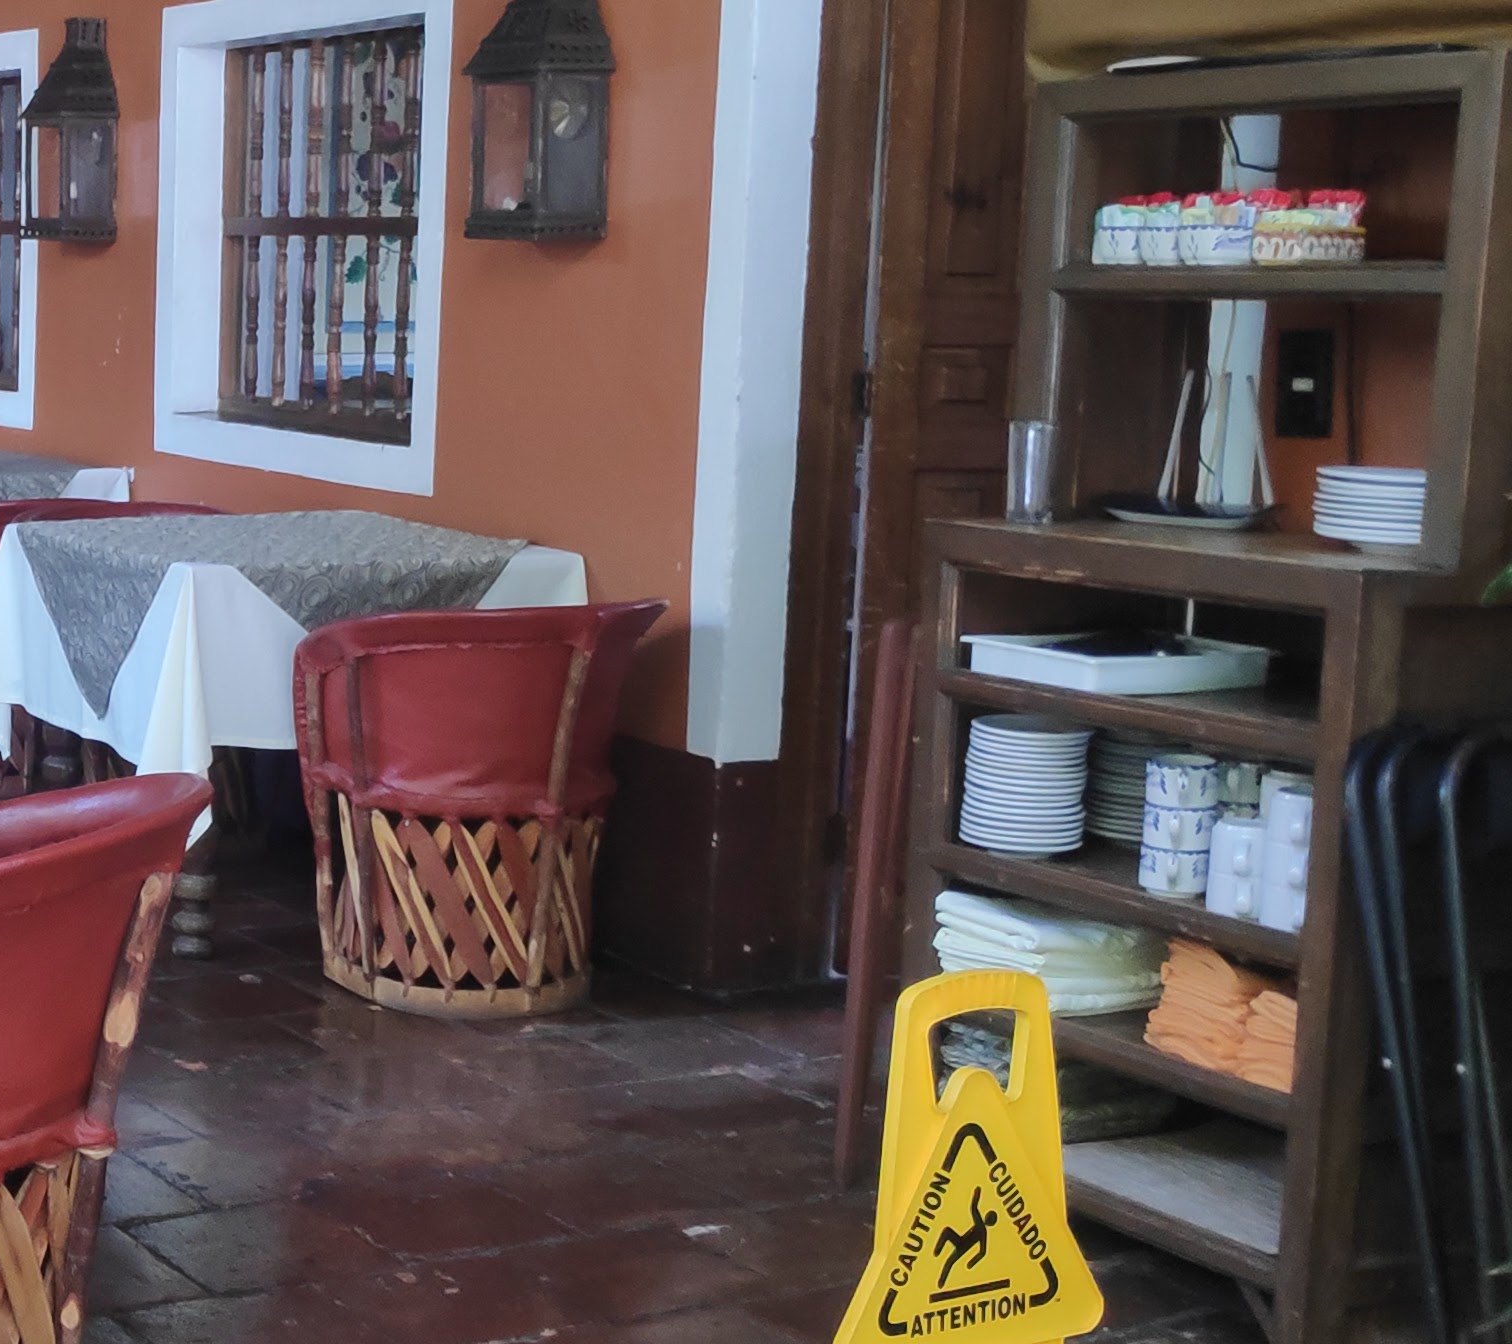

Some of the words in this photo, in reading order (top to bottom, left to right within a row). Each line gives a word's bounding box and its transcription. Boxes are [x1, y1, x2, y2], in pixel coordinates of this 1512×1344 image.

[889, 1170, 952, 1287] CAUTION
[988, 1160, 1048, 1261] CUIDADO
[910, 1292, 1027, 1339] ATTENTION
